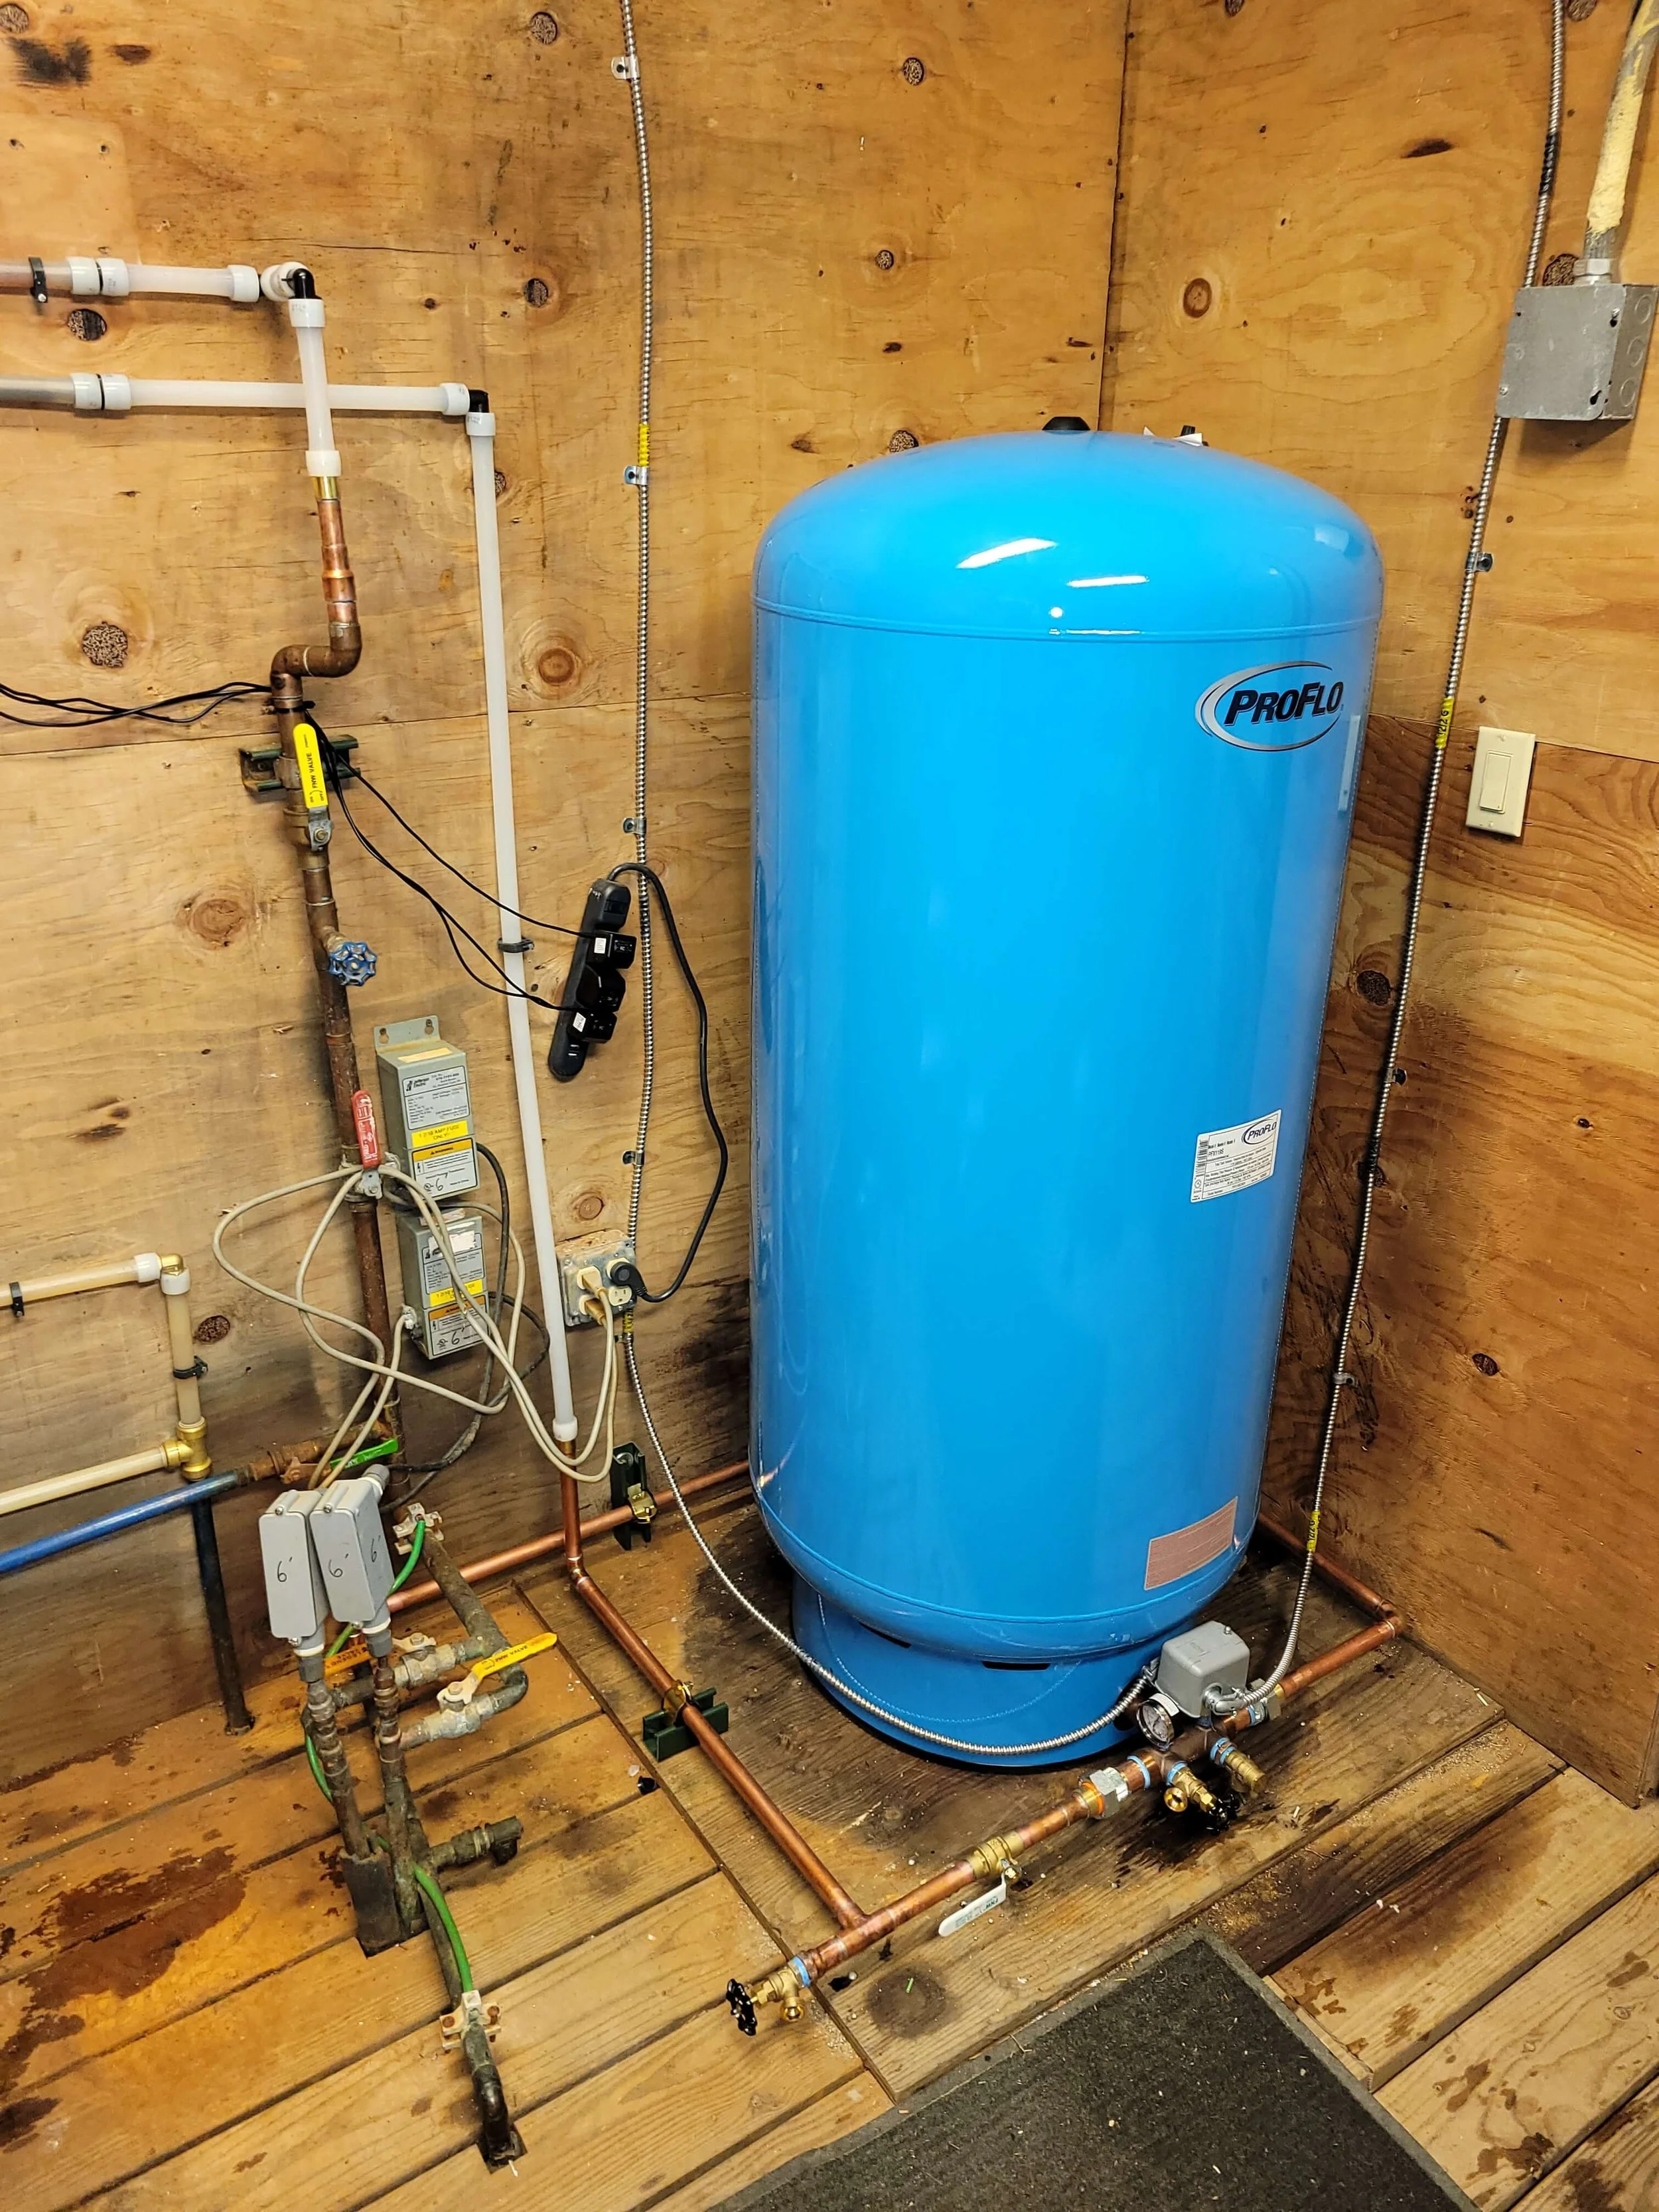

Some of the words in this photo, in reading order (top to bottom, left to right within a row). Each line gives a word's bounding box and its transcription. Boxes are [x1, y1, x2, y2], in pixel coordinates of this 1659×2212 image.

[1224, 682, 1344, 726] PROFLO
[277, 1556, 293, 1582] 6'
[328, 1553, 349, 1578] 6'
[509, 1645, 528, 1655] VALVE
